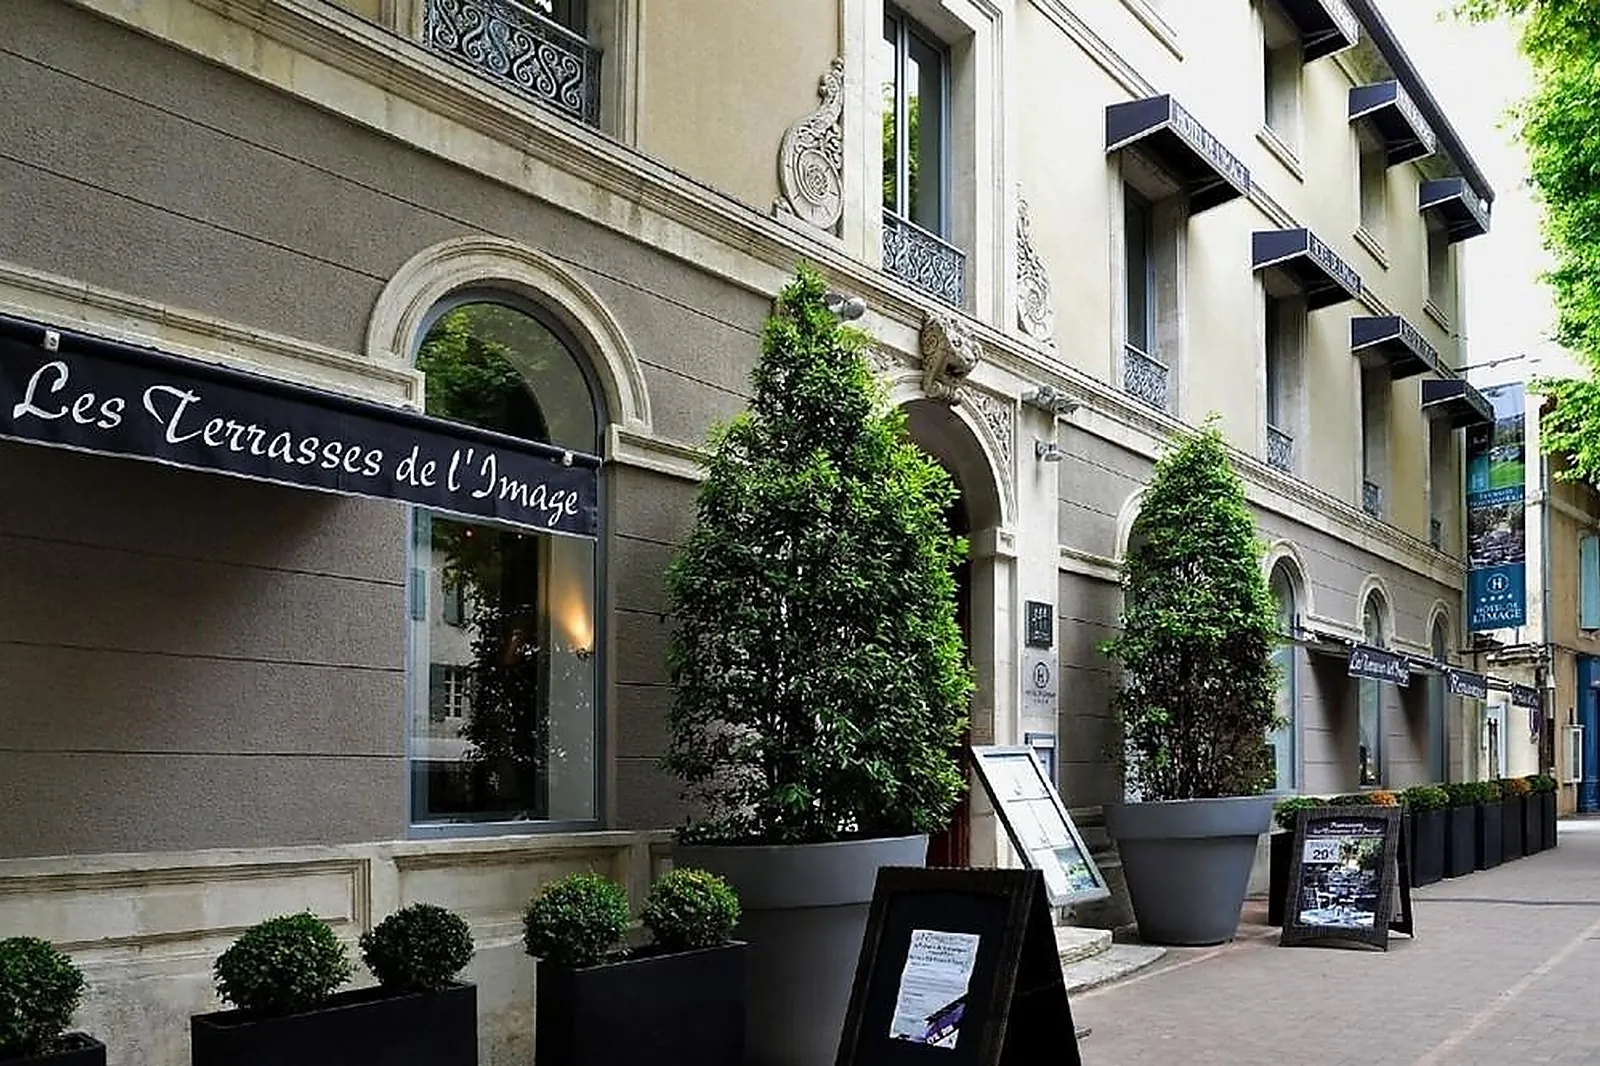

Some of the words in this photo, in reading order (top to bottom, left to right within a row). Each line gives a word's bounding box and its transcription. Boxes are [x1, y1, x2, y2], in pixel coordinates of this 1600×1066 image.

[13, 360, 126, 429] Les
[143, 384, 384, 477] Terrasses
[396, 445, 437, 487] de
[448, 448, 579, 526] l'Image
